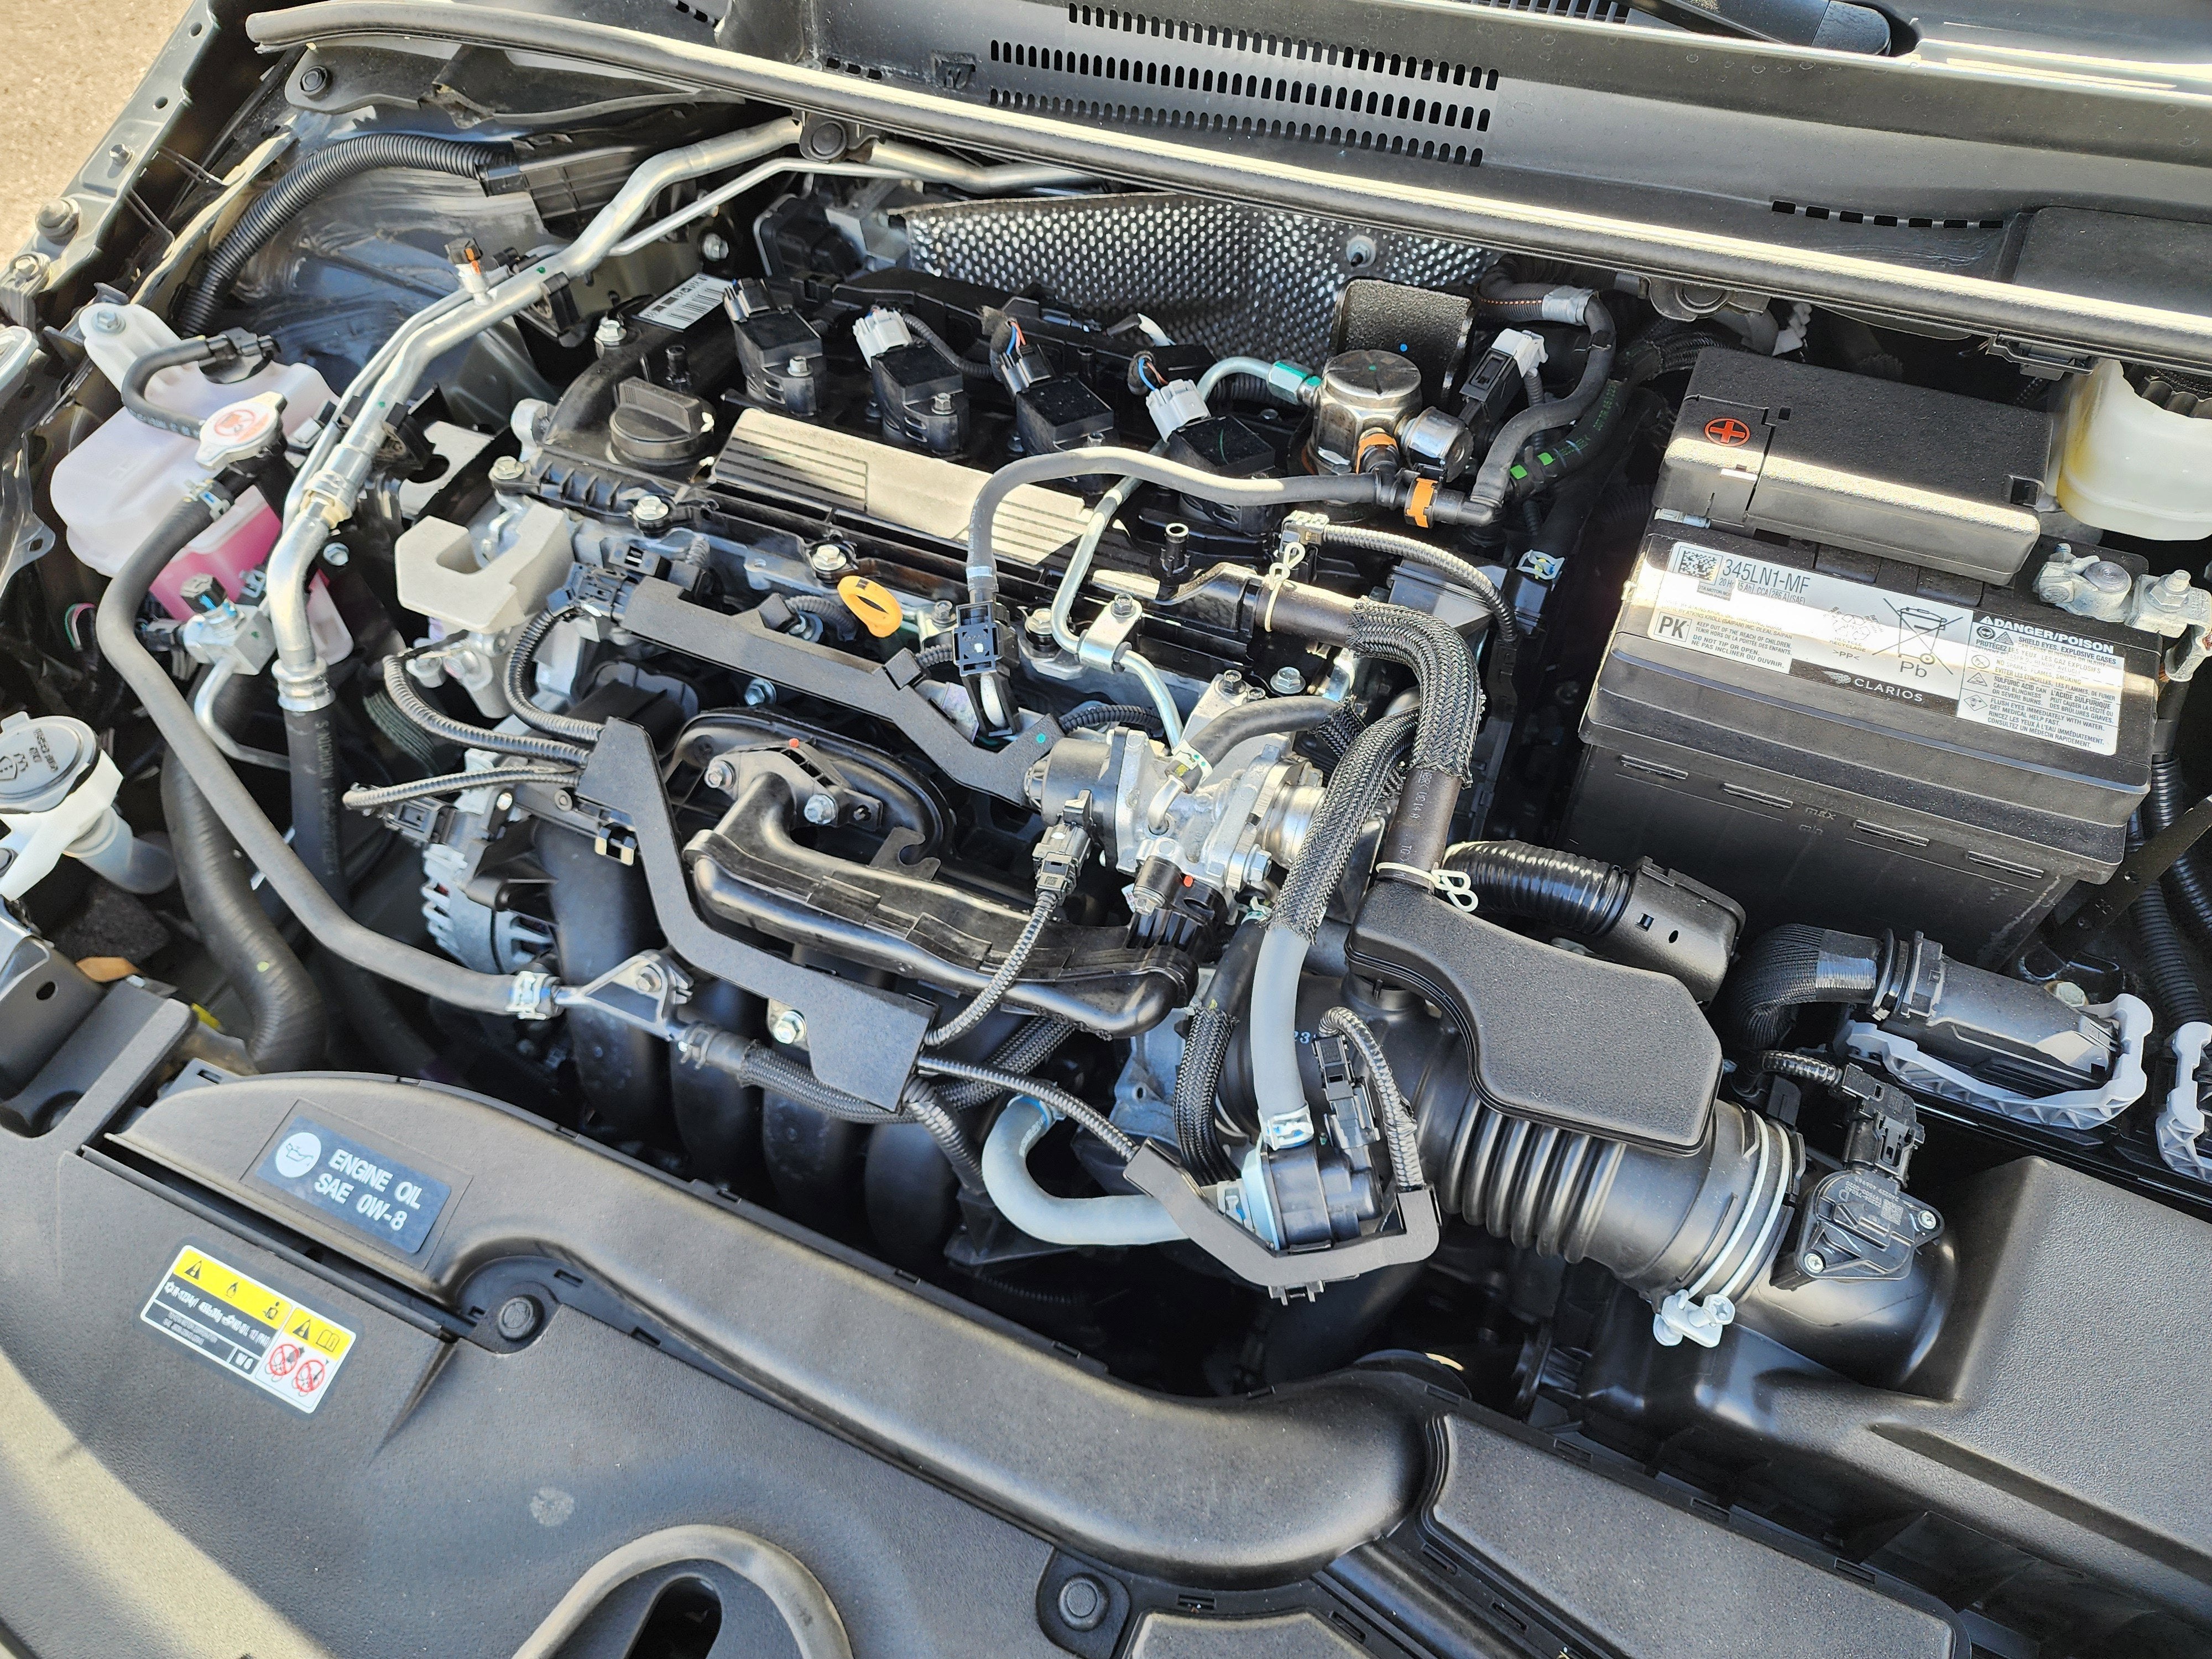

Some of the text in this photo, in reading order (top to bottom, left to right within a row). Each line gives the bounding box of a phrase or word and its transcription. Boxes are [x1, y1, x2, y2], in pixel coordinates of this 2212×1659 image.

[1723, 559, 1809, 594] 345LN1-MF
[1756, 587, 1768, 596] CCA
[1771, 591, 1782, 599] 286
[1659, 617, 1686, 637] PK
[1686, 609, 1704, 618] ATKINS
[1721, 618, 1744, 628] (SAIPAN)
[1773, 631, 1792, 639] SAIPAN
[1739, 632, 1756, 640] REACH
[1765, 638, 1792, 648] CHILDREN.
[1993, 619, 2114, 653] DANGER/POISON
[1740, 646, 1760, 655] OPEN.
[1768, 645, 1792, 655] ENFANTS.
[1829, 640, 1866, 653] RECYCLAGE
[1975, 638, 2008, 651] PROTÉGEZ
[2067, 661, 2101, 673] EXPLOSIFS
[2018, 637, 2039, 646] SHIELD
[2060, 647, 2096, 660] EXPLOSIVE
[2097, 655, 2116, 664] GASES
[1714, 646, 1745, 658] INCLINER
[1757, 656, 1785, 668] OUVRIR.
[1900, 660, 1928, 678] Pb
[1994, 676, 2020, 687] SULFURIC
[2055, 674, 2081, 685] SMOKING
[1854, 677, 1923, 702] CLARIOS
[2001, 691, 2022, 700] SEVERE
[2022, 696, 2043, 706] BURNS.
[2011, 687, 2042, 698] BLINDNESS
[2064, 685, 2090, 695] FLAMMES,
[2098, 692, 2116, 701] FUMER
[2051, 690, 2111, 709] L'ACIDE SULFURIQUE
[2063, 700, 2081, 708] CAUSER
[1990, 698, 2009, 707] FLUSH
[2026, 707, 2064, 720] IMMEDIATELY
[2082, 721, 2105, 731] WATER.
[2001, 707, 2027, 717] MEDICAL
[2060, 705, 2090, 717] BRÛLURES
[2090, 713, 2115, 723] GRAVES.
[1987, 717, 2018, 728] CONSULTEZ
[2029, 726, 2054, 738] MÉDECIN
[2054, 734, 2092, 748] RAPIDEMENT.
[1988, 711, 2008, 719] RINCEZ
[2057, 727, 2105, 744] IMMÉDIATEMENT.
[328, 1149, 422, 1209] ENGINE OIL
[315, 1173, 408, 1231] SAE 0W-8
[1839, 1188, 1850, 1202] D
